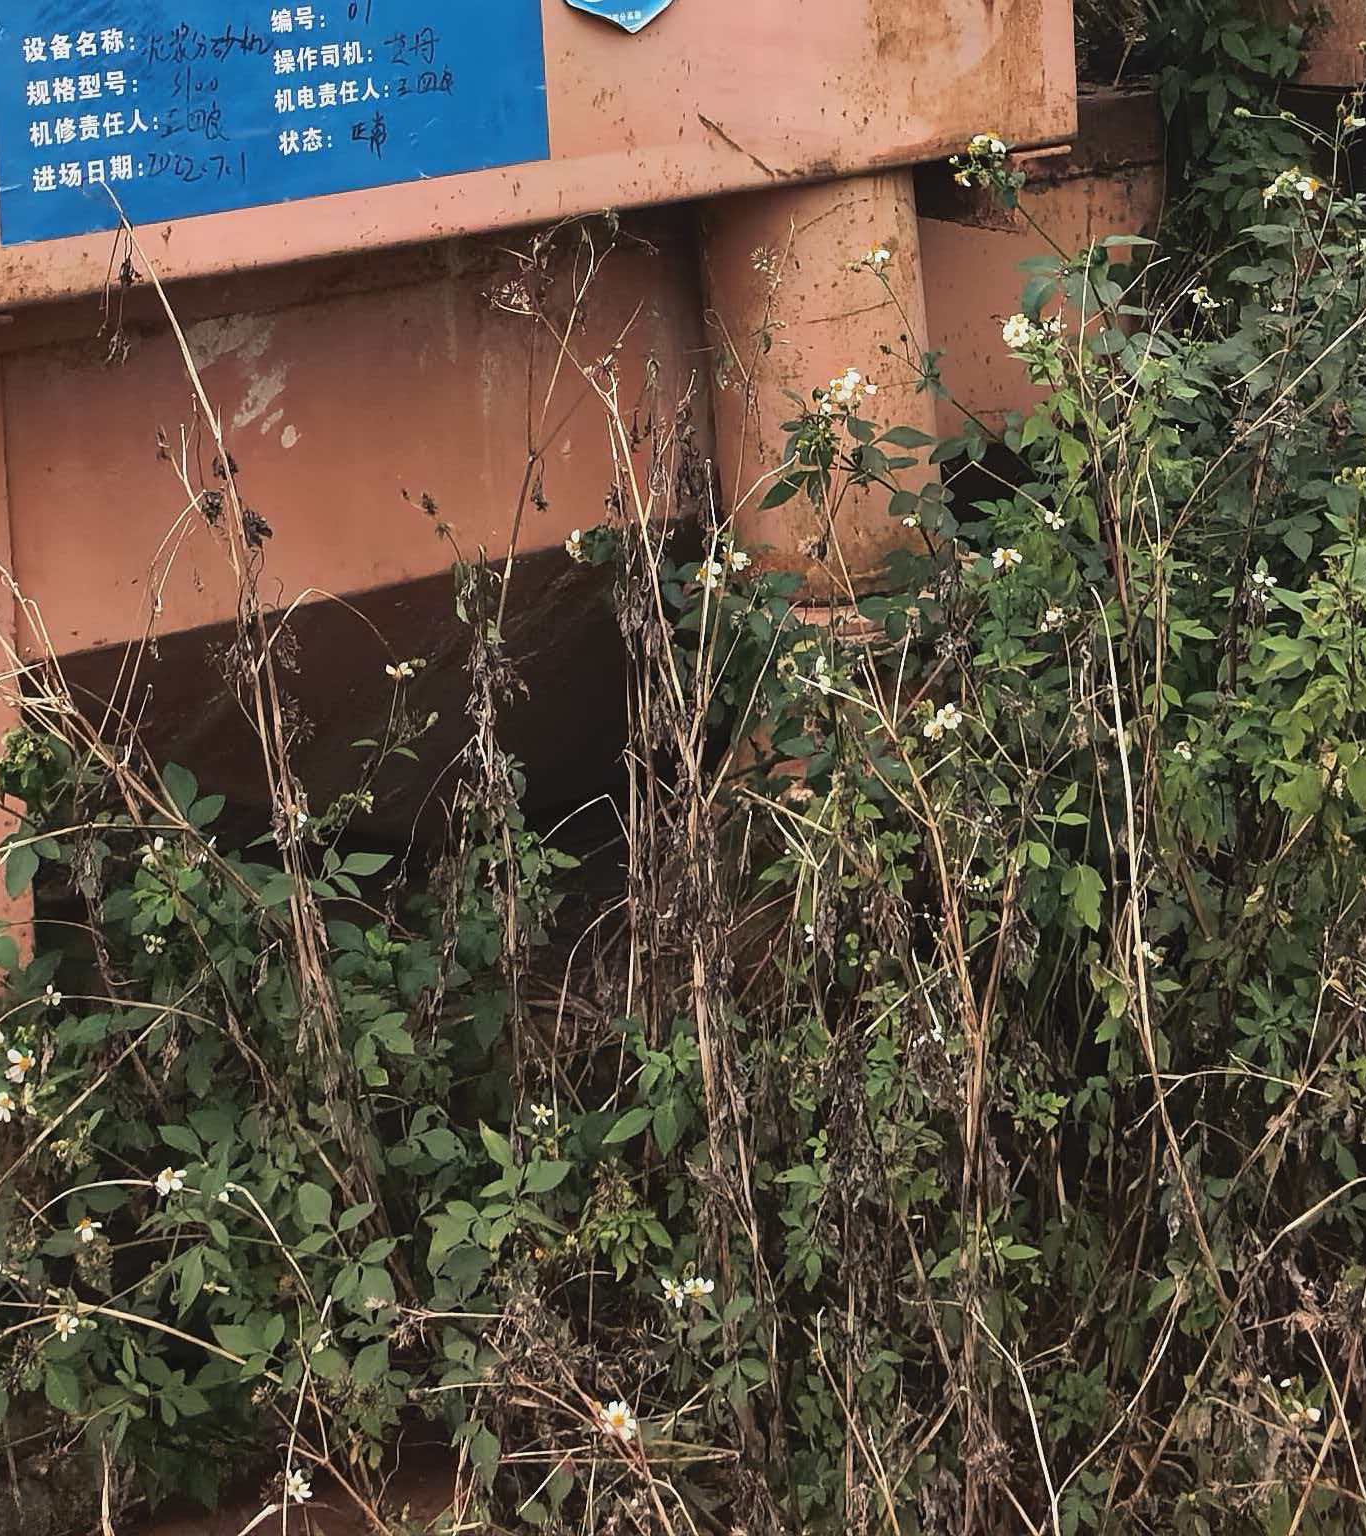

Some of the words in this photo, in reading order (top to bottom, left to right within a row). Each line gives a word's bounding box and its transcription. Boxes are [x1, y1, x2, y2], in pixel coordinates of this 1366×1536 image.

[22, 26, 136, 64] 设备名称：
[273, 40, 375, 75] 操作司机：
[26, 70, 138, 107] 规格型号：
[274, 77, 389, 114] 机电责任人：
[29, 108, 159, 148] 机修责任人：
[32, 154, 145, 193] 进场日期：
